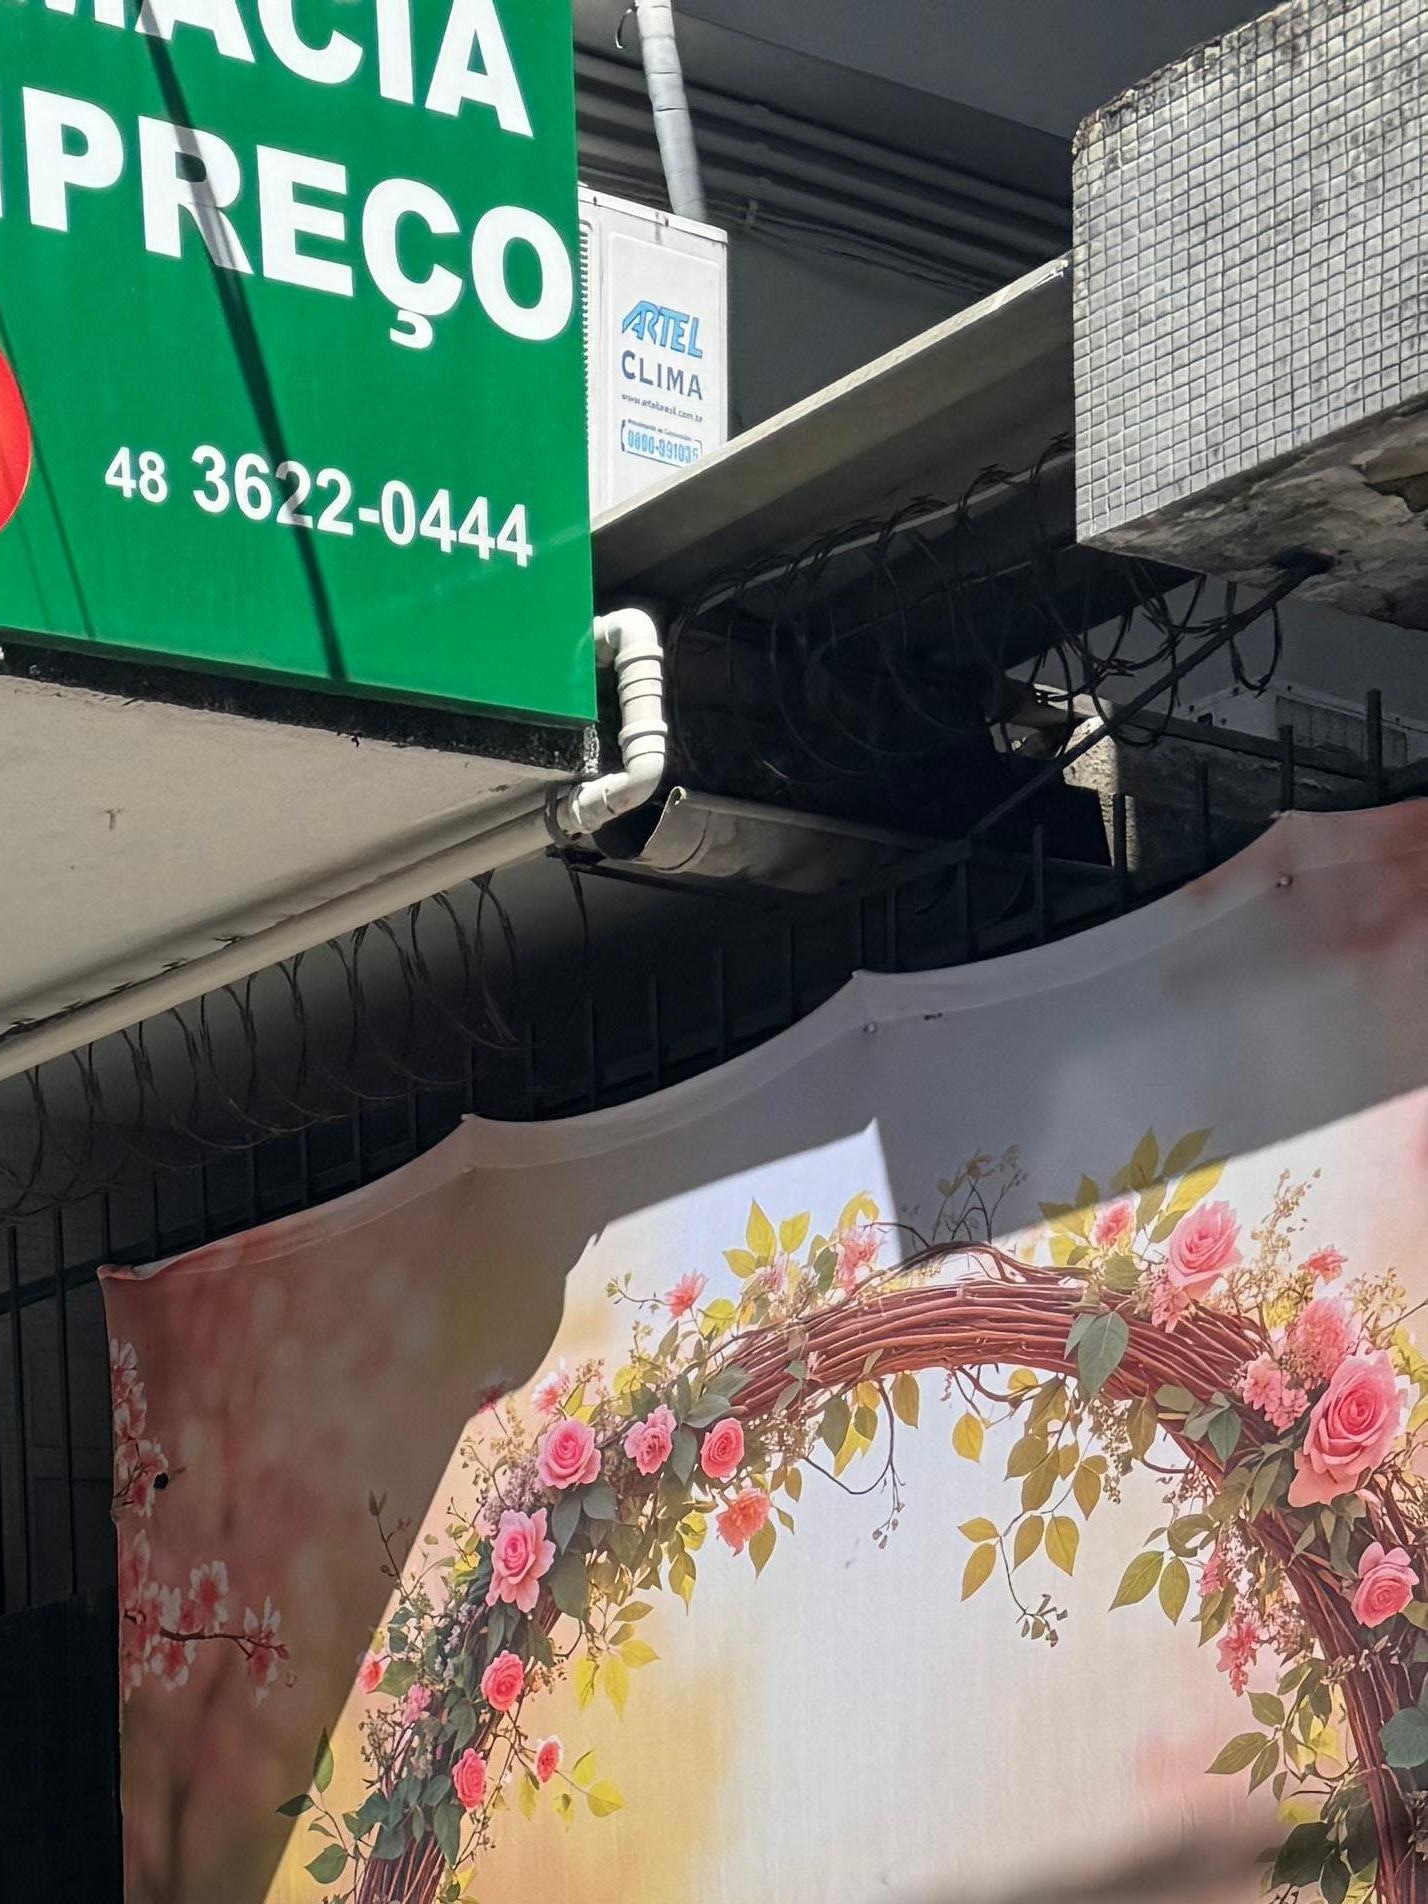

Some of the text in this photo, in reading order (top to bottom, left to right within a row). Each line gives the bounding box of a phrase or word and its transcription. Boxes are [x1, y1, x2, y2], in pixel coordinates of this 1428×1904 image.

[622, 300, 703, 358] ARTEL
[622, 350, 703, 400] CLIMA
[106, 445, 535, 568] 48 3622-0444
